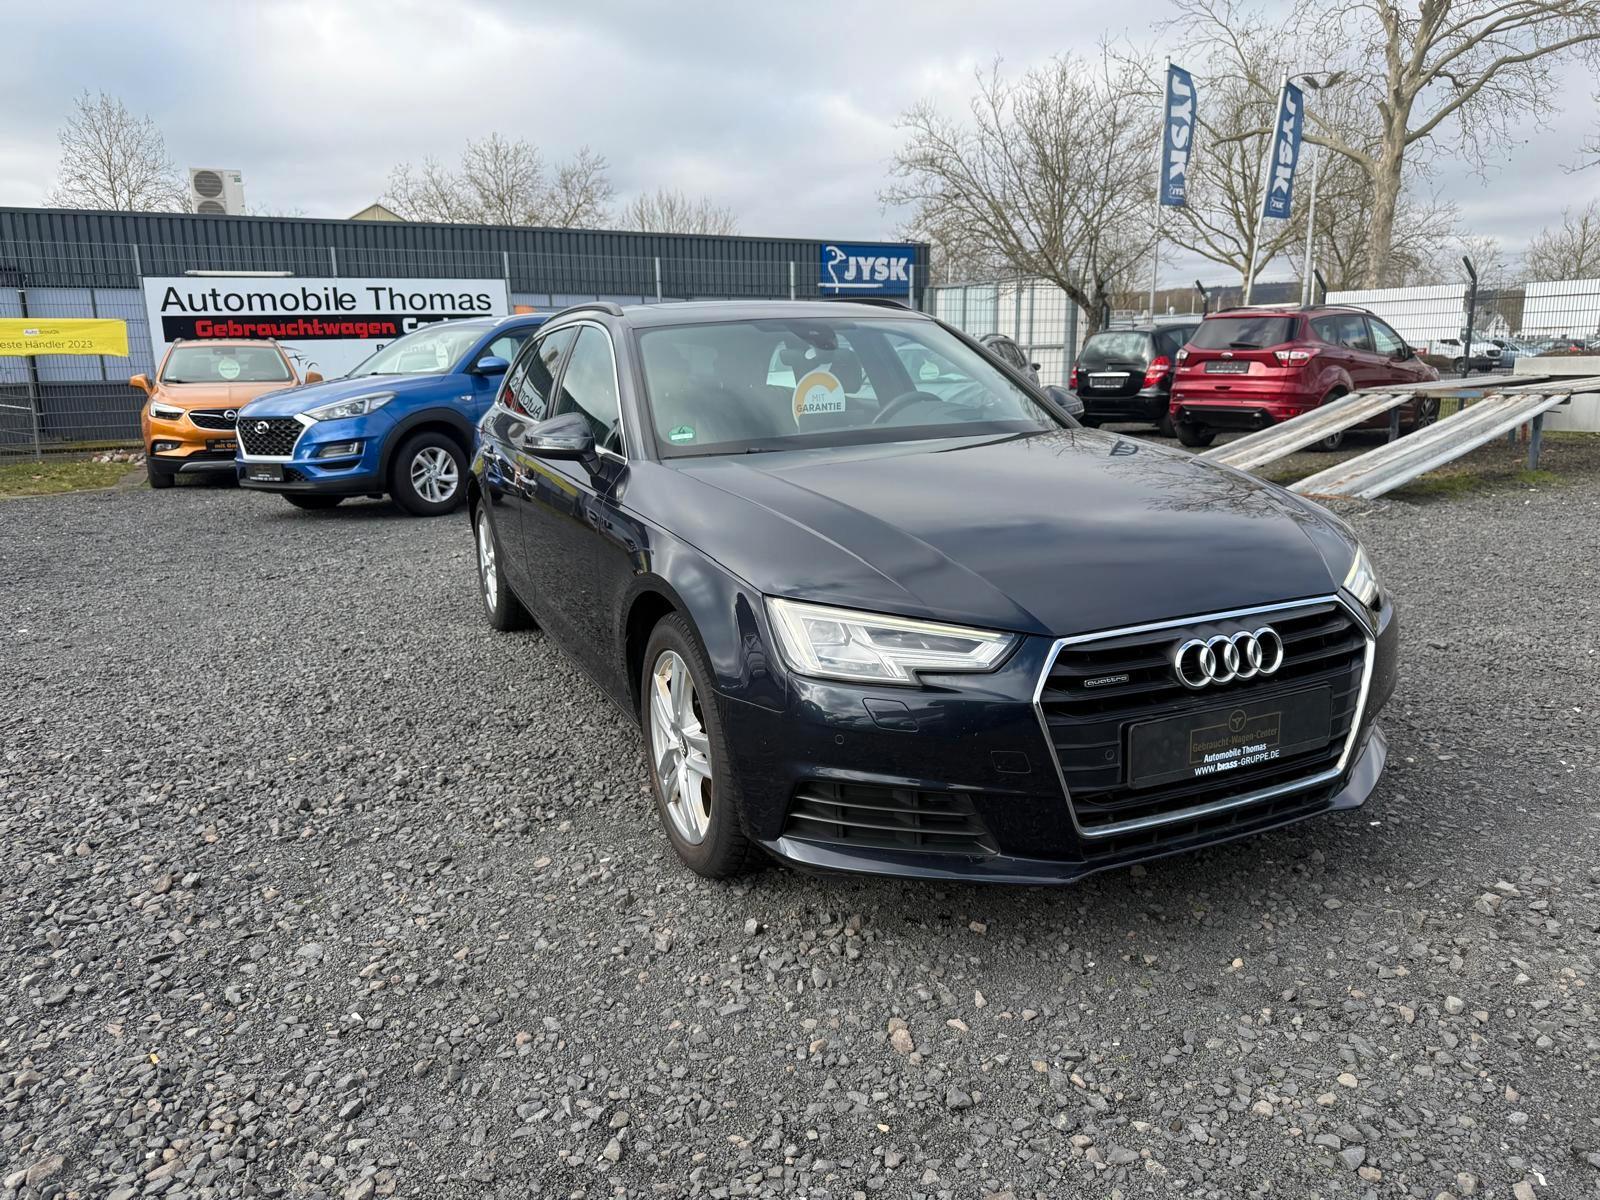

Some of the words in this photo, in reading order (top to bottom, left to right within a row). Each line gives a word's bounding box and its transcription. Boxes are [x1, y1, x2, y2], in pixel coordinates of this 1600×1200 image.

[1169, 74, 1192, 180] JYSK
[1271, 90, 1296, 195] JYSK
[844, 256, 908, 281] JYSK
[160, 286, 357, 312] Automobile
[366, 286, 492, 311] Thomas
[195, 319, 397, 339] Gebrauchtwagen
[25, 340, 65, 349] Händler
[68, 340, 93, 349] 2023
[796, 402, 842, 412] GARANTIE
[811, 393, 825, 401] MIT
[1087, 676, 1127, 687] quattro
[1203, 748, 1241, 763] Automobile
[1242, 743, 1267, 755] Thomas
